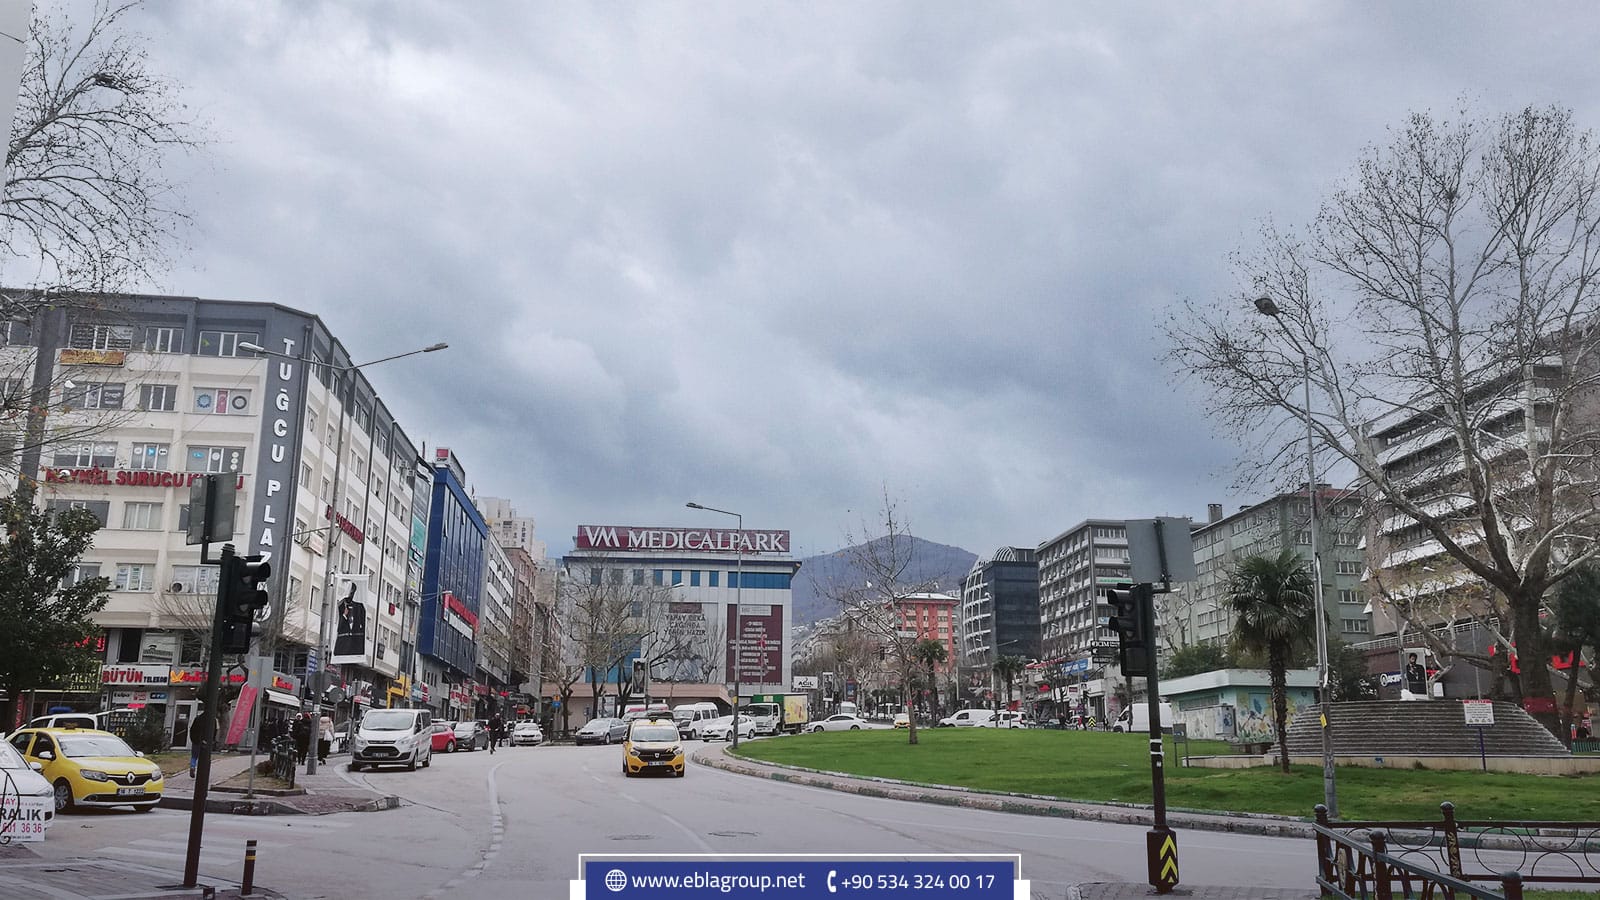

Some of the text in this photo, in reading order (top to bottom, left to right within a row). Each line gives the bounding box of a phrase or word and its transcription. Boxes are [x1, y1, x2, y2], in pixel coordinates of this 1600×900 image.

[270, 336, 296, 463] TUĞCU
[584, 525, 785, 551] VM MEDICALPARK
[102, 668, 143, 683] BÜTÜN
[21, 823, 31, 833] 36
[33, 823, 42, 833] 36
